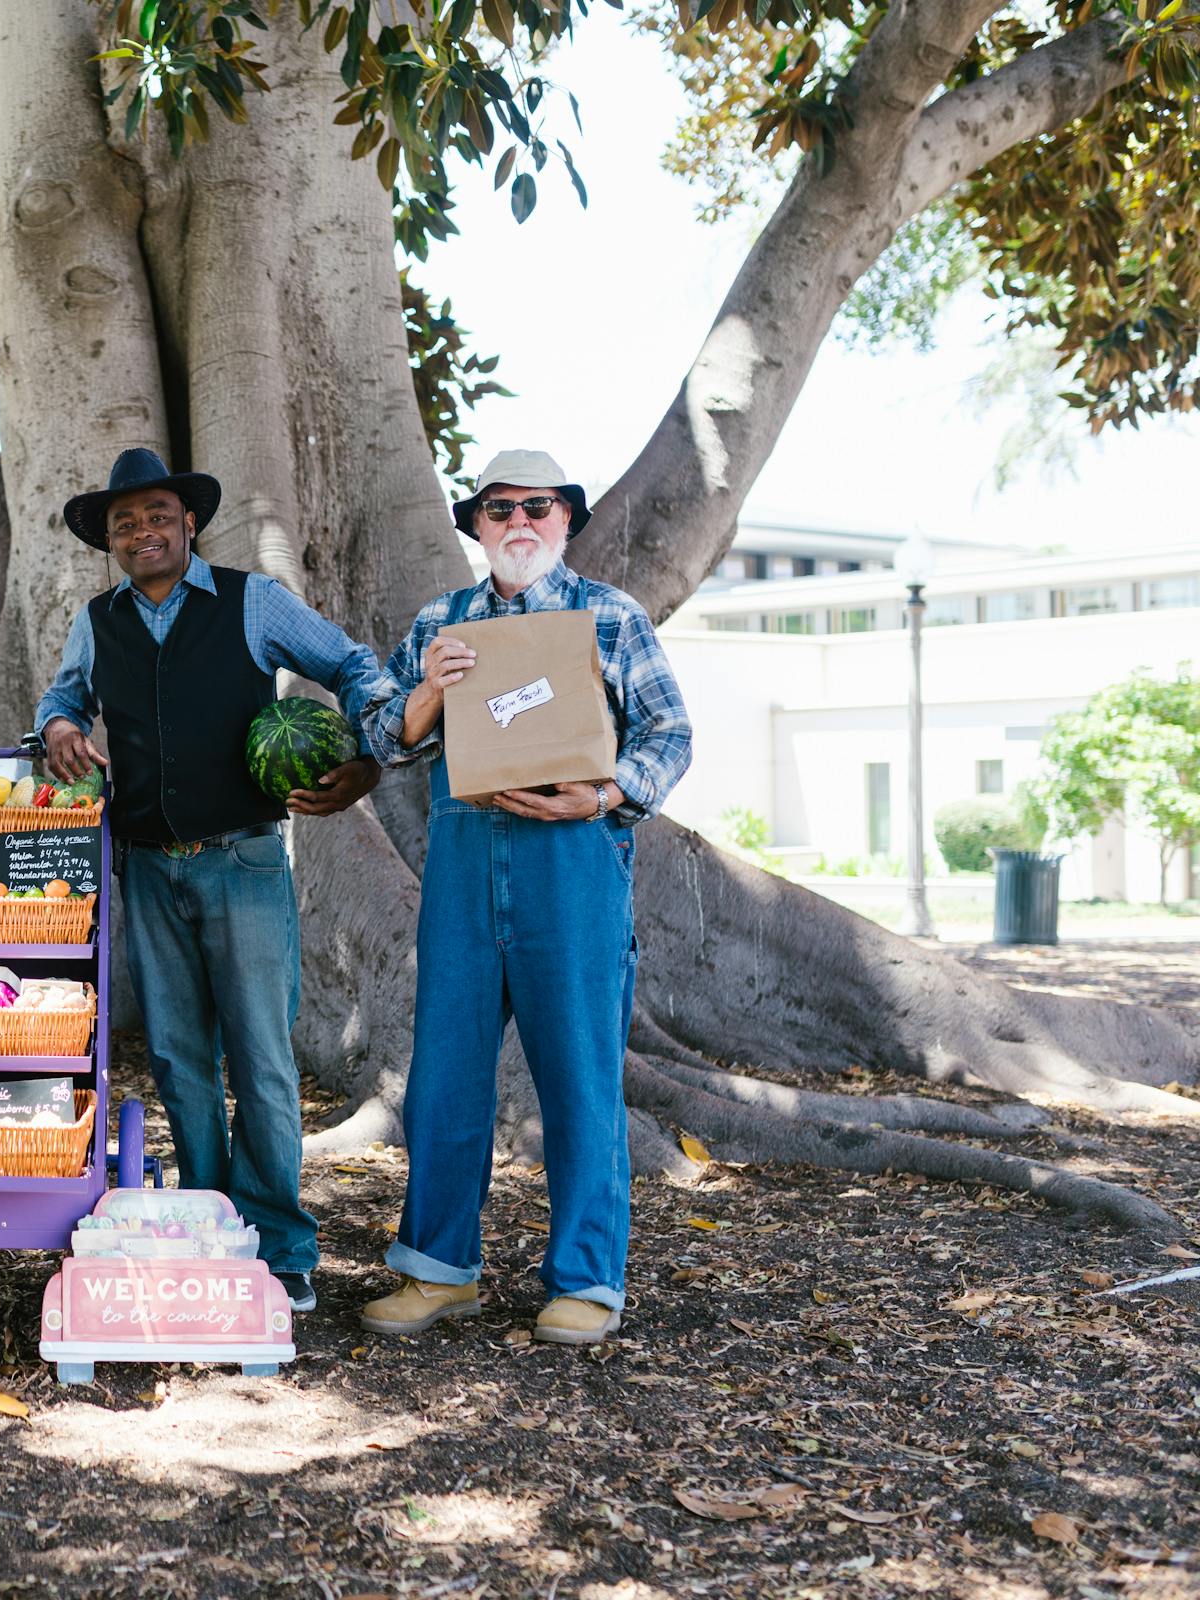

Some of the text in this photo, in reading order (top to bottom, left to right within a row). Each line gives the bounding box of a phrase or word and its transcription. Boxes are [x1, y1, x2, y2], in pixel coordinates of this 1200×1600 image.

[493, 697, 516, 714] Farm
[5, 834, 35, 850] Organic
[82, 1277, 254, 1301] WELCOME
[102, 1305, 239, 1333] to the country
